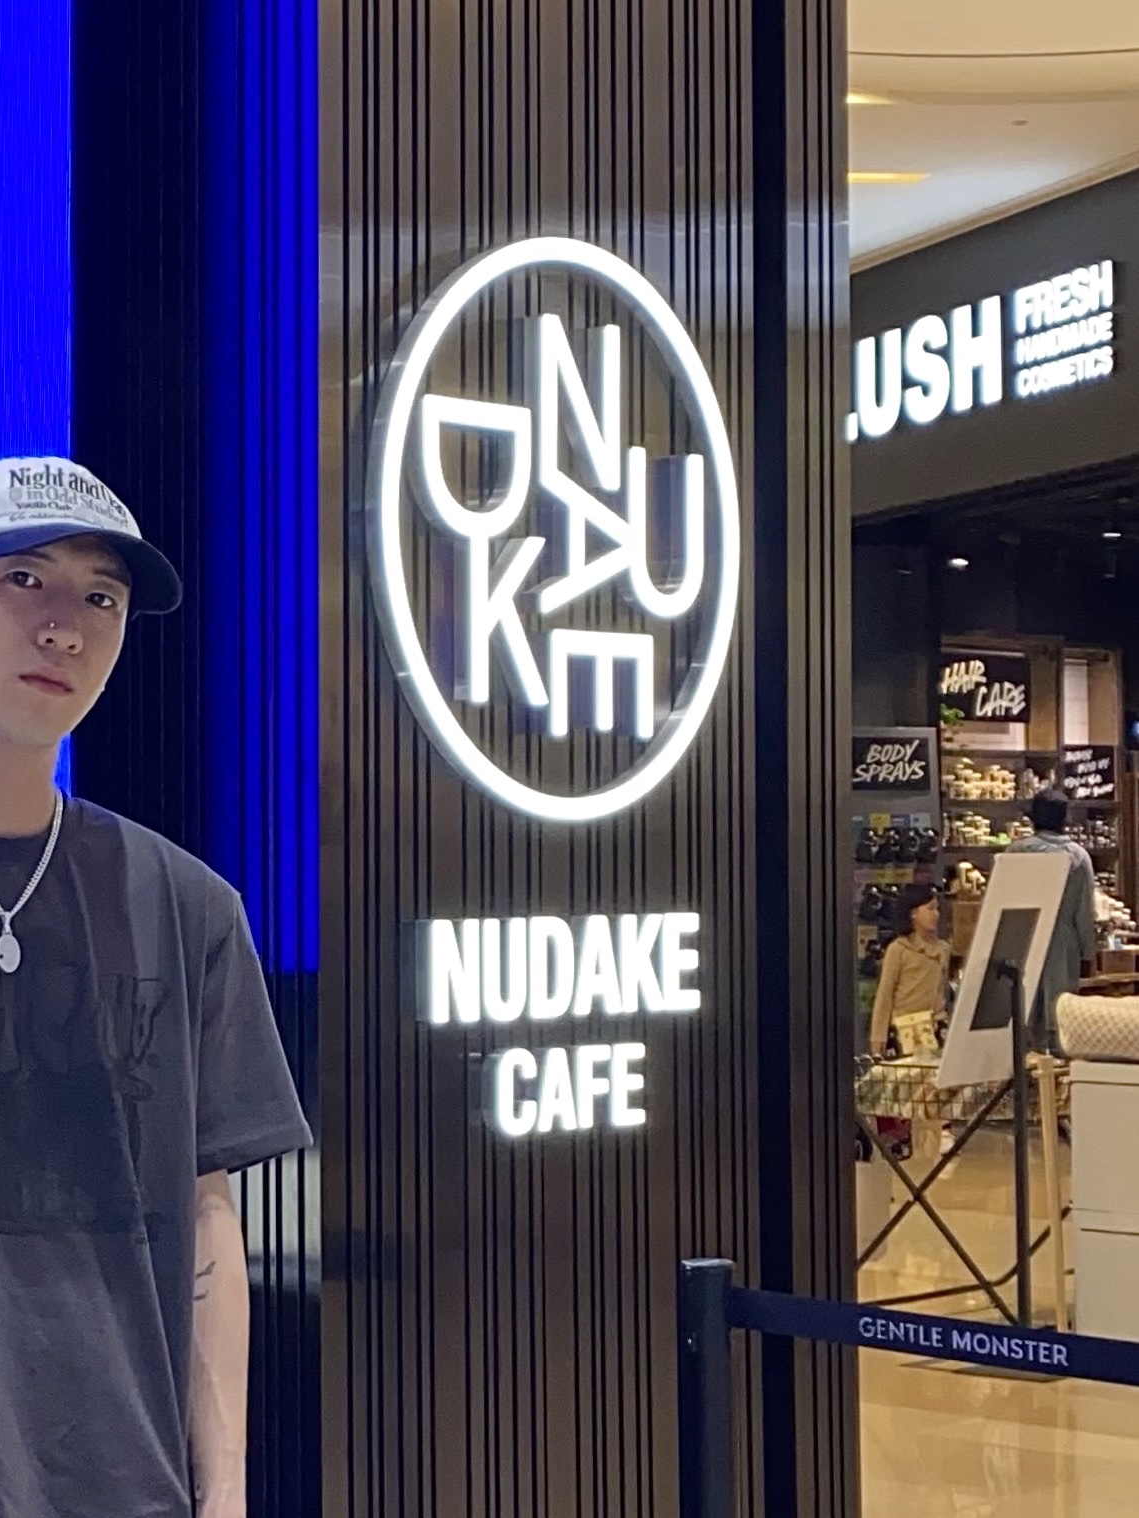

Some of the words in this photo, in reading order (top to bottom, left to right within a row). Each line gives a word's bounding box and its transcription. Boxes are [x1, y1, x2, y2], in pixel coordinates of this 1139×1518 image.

[1015, 260, 1113, 334] FRESH
[1016, 311, 1113, 365] HANDMADE
[845, 294, 1003, 444] USH
[1016, 345, 1113, 397] COSMETICS
[9, 464, 64, 489] Night
[69, 472, 101, 500] and
[940, 660, 987, 695] HAIR
[975, 684, 1026, 717] CARE
[852, 760, 925, 782] SPRAYS
[867, 740, 920, 764] BODY
[431, 912, 701, 1024] NUDAKE
[497, 1042, 646, 1136] CAFE
[859, 1317, 943, 1348] GENTLE
[952, 1329, 1069, 1367] MONSTER
